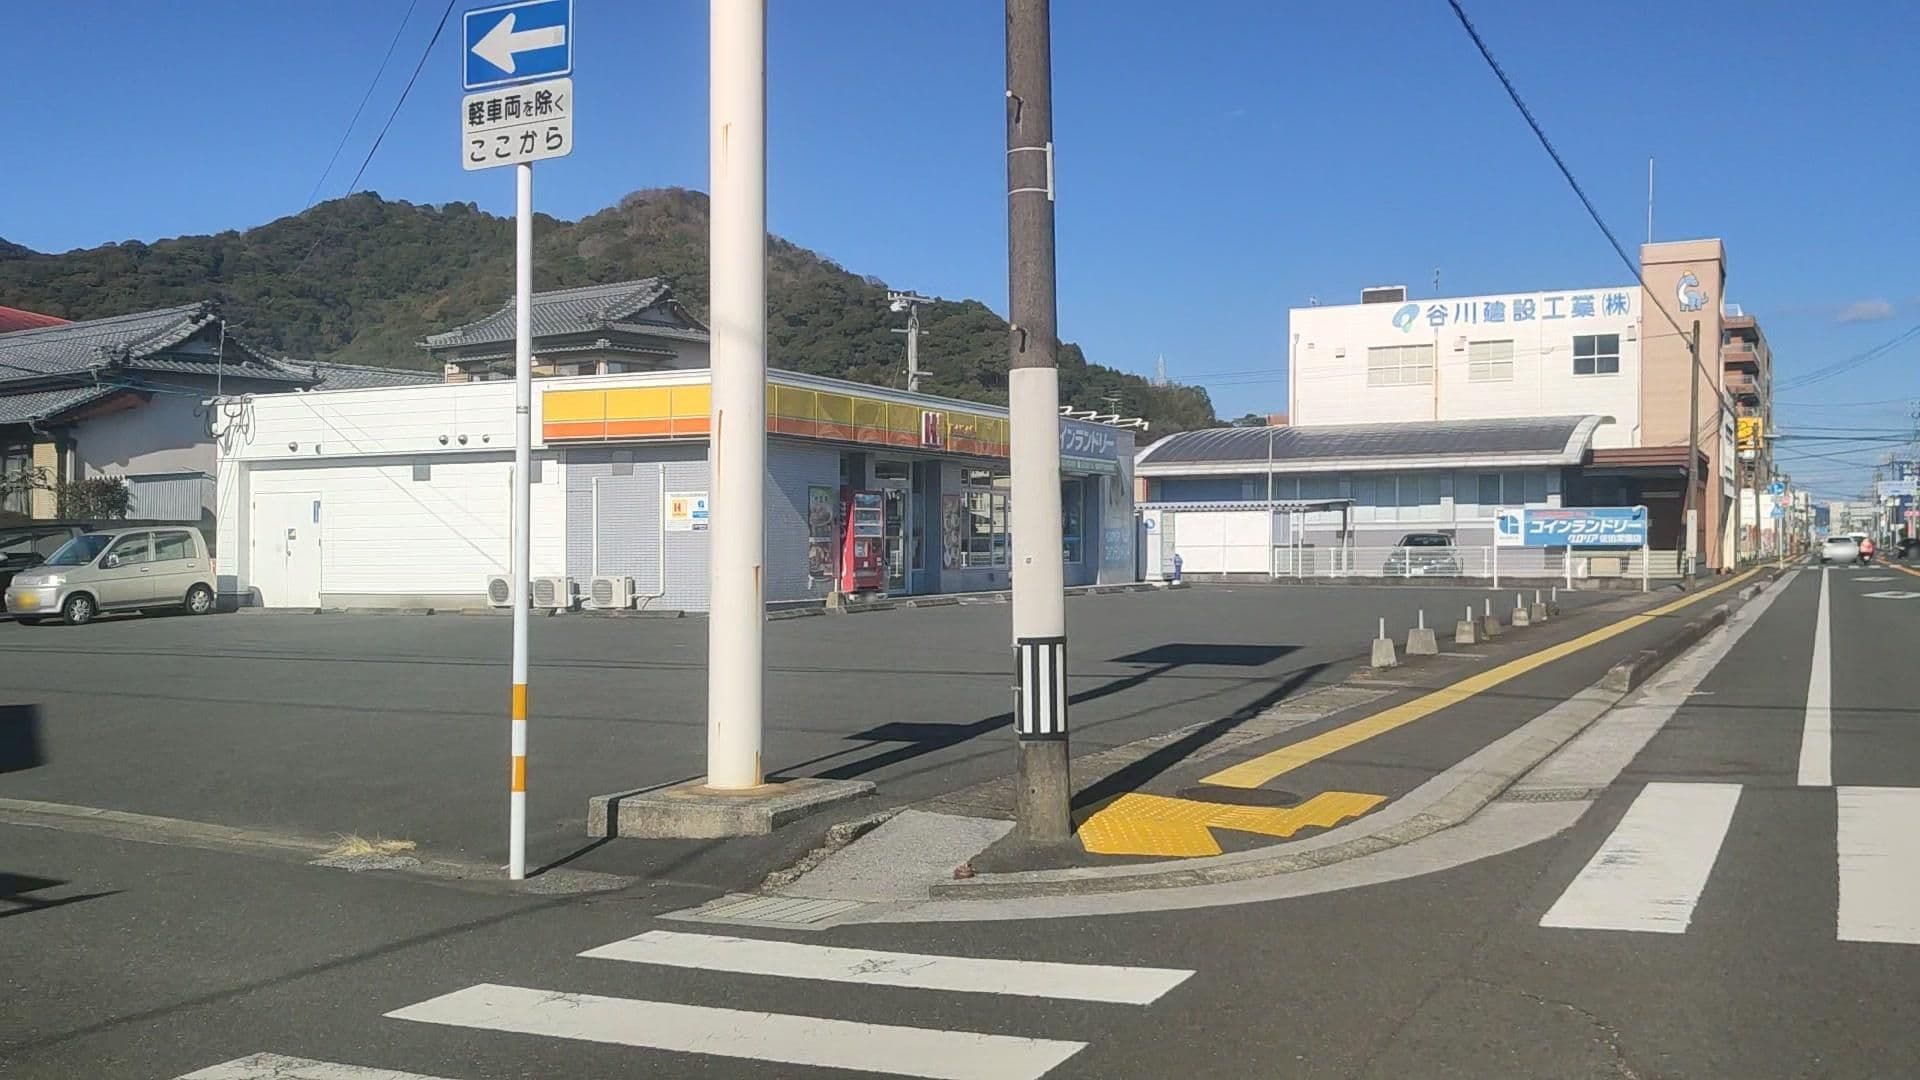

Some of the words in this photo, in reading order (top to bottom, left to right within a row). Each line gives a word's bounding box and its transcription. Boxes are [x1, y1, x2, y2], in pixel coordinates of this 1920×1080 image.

[468, 89, 565, 127] 軽車両を除く
[470, 126, 563, 162] ここから
[1426, 291, 1631, 328] 谷川建設工業(株)
[1060, 424, 1115, 454] インランドリー
[1529, 519, 1642, 534] コインランドリー
